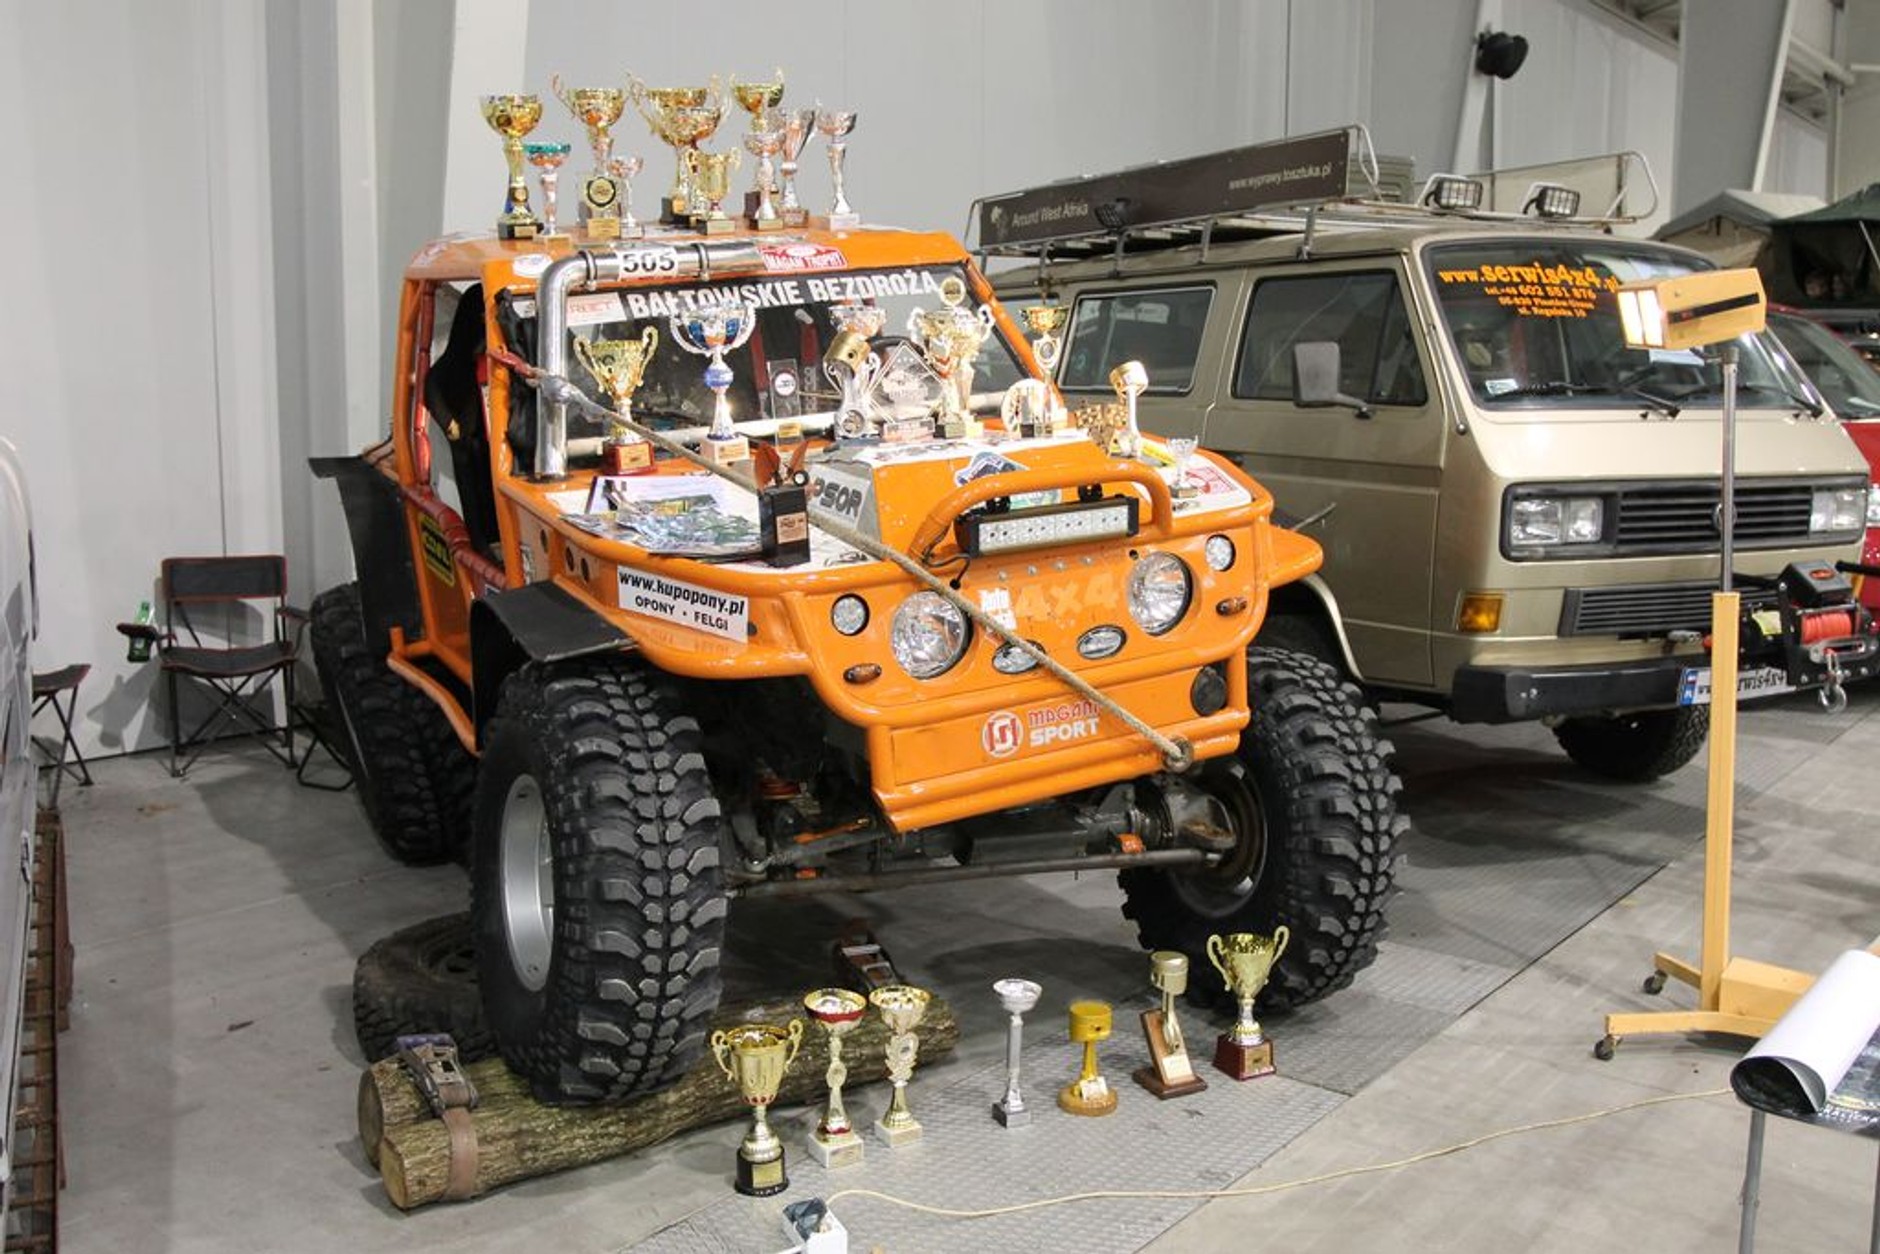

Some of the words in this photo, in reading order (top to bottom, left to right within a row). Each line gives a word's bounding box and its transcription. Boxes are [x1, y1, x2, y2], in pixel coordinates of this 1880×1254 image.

[622, 251, 676, 274] 505
[626, 280, 804, 319] BAŁTOWSKIE
[806, 269, 940, 302] BEZDROŻA
[619, 571, 745, 617] www.kupopony.pl
[635, 595, 676, 617] OPONY
[694, 611, 729, 632] FELGI
[1029, 717, 1100, 748] SPORT
